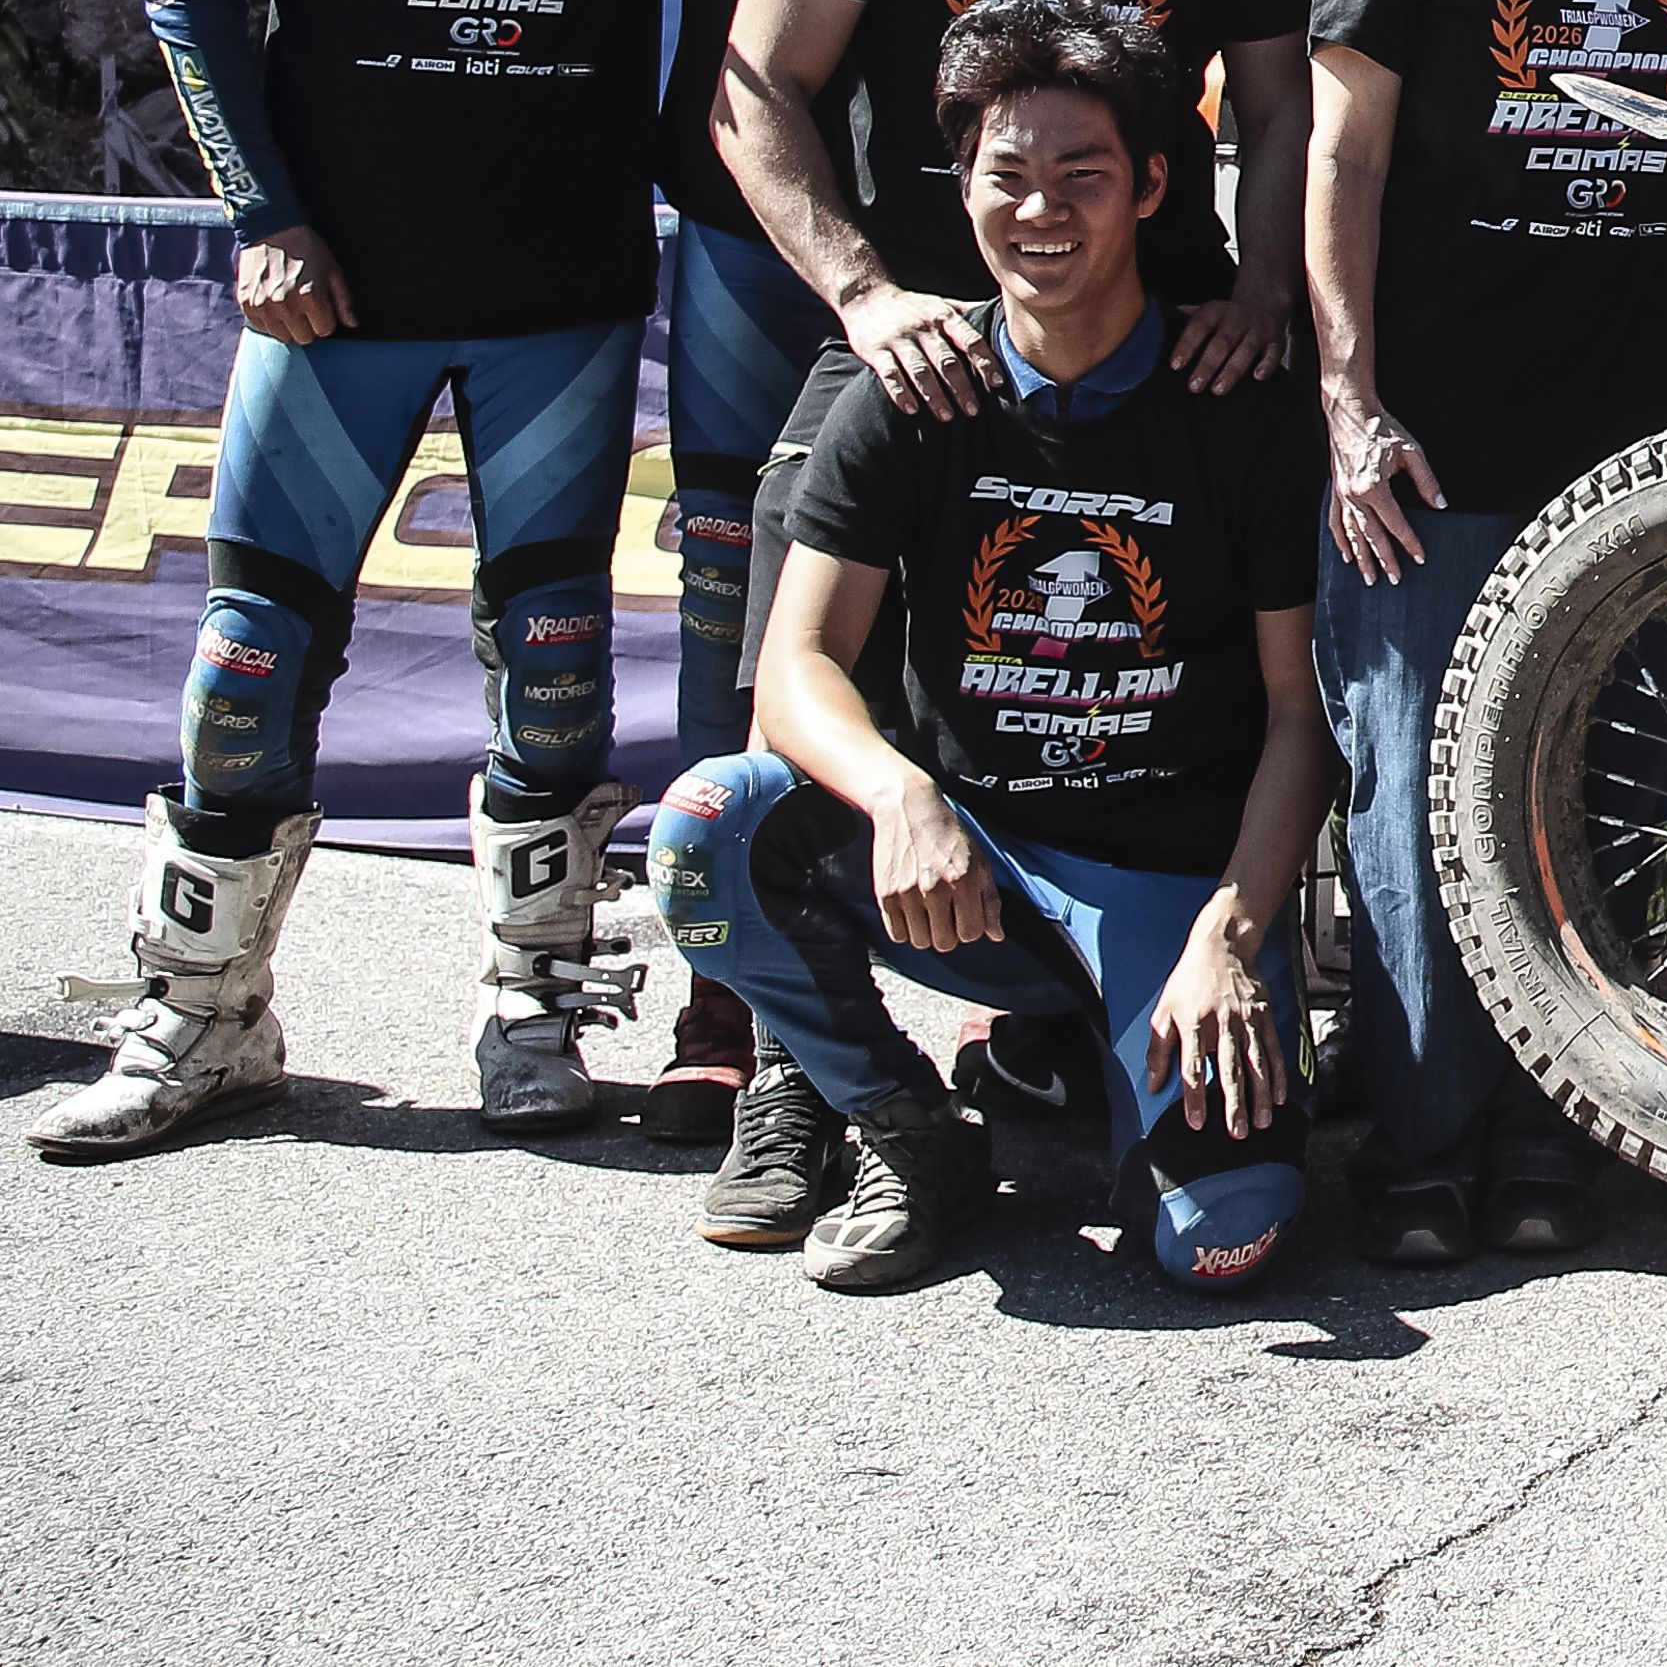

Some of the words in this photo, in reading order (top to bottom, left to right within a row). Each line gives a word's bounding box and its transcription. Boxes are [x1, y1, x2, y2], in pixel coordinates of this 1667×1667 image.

[450, 17, 522, 47] GRO
[1560, 8, 1636, 27] TRIALGPWOMEN
[1531, 25, 1581, 44] 2026
[411, 58, 455, 72] AIROH
[466, 57, 499, 75] iati
[1525, 147, 1667, 173] COMAS
[1566, 179, 1626, 209] GRO
[970, 476, 1174, 525] SCORPA
[992, 612, 1142, 641] CHAMPION
[960, 662, 1184, 705] ABELLAN
[995, 710, 1152, 736] COMAS
[1469, 573, 1570, 864] COMPETITION
[1041, 736, 1106, 766] GRO
[1009, 777, 1053, 791] AIROH
[1486, 896, 1558, 1026] TRIAL
